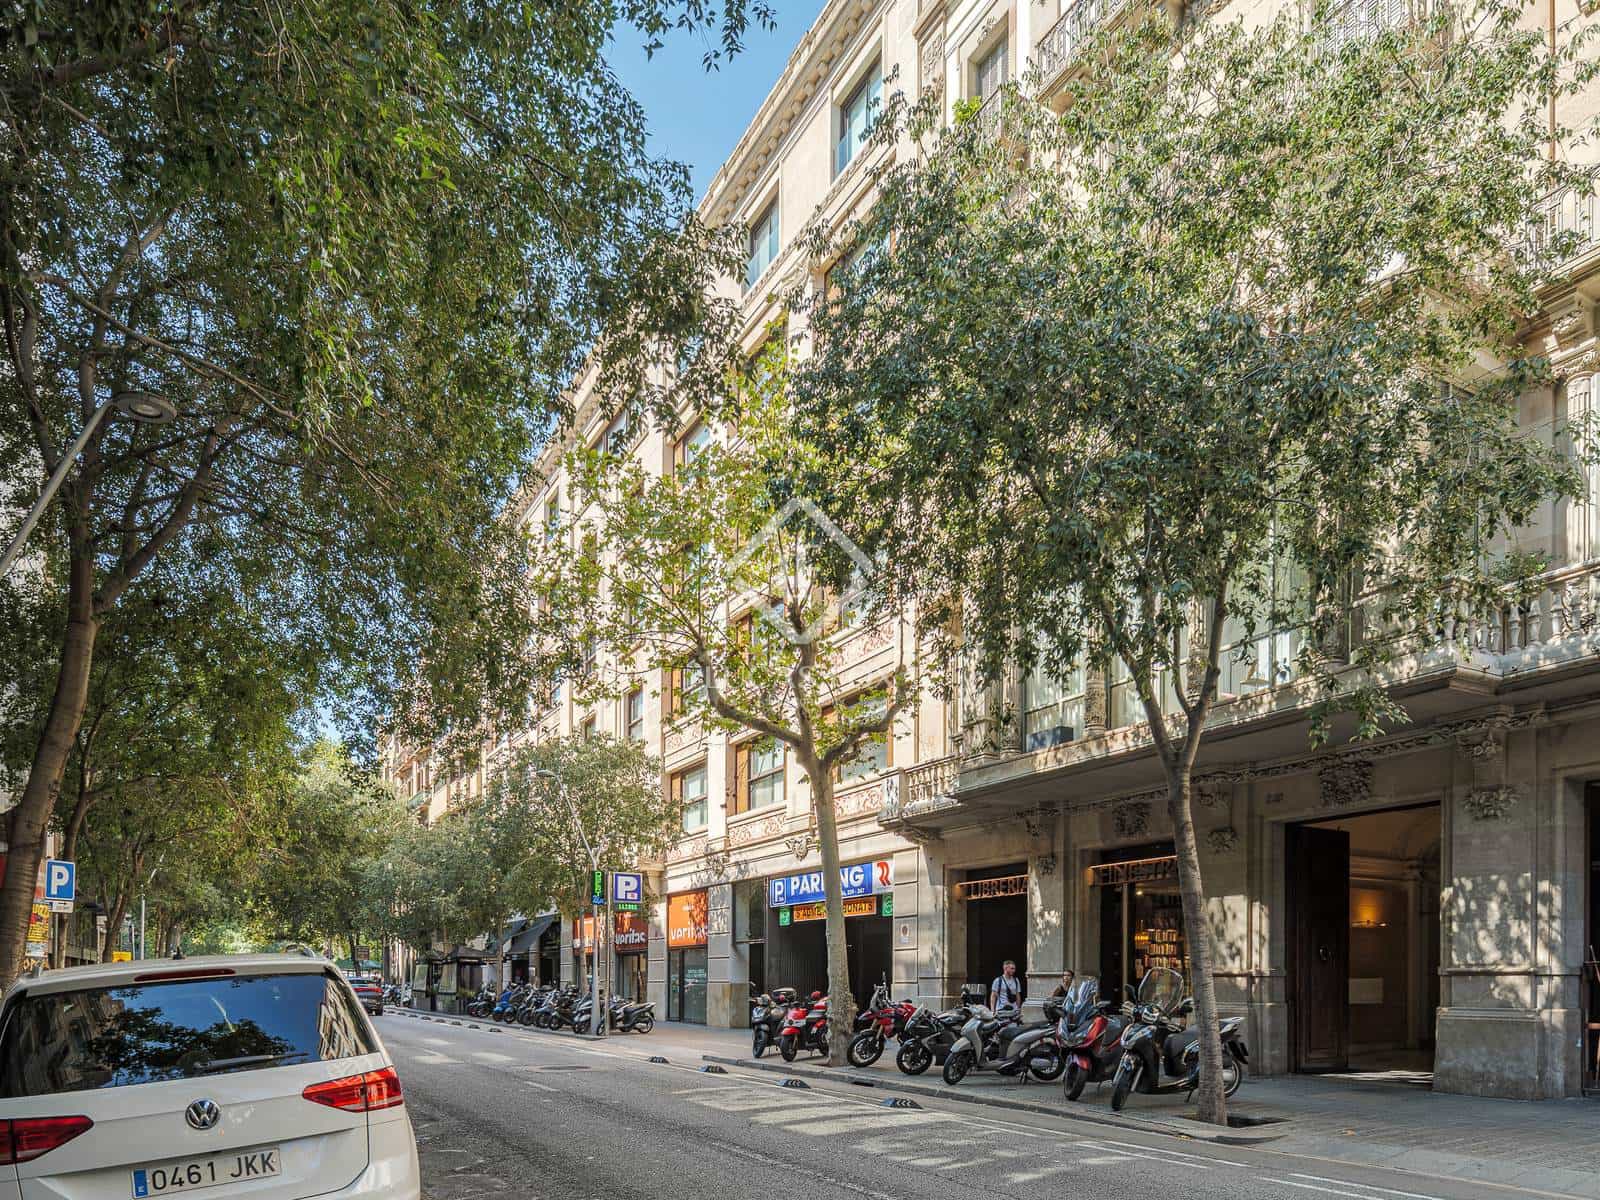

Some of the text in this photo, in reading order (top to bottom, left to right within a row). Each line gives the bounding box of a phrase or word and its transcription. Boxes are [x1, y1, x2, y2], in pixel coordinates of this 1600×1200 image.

[50, 864, 69, 896] P
[617, 876, 638, 899] P
[774, 881, 784, 902] P
[791, 866, 864, 896] PARNG
[152, 1152, 275, 1190] 0461 JKK
